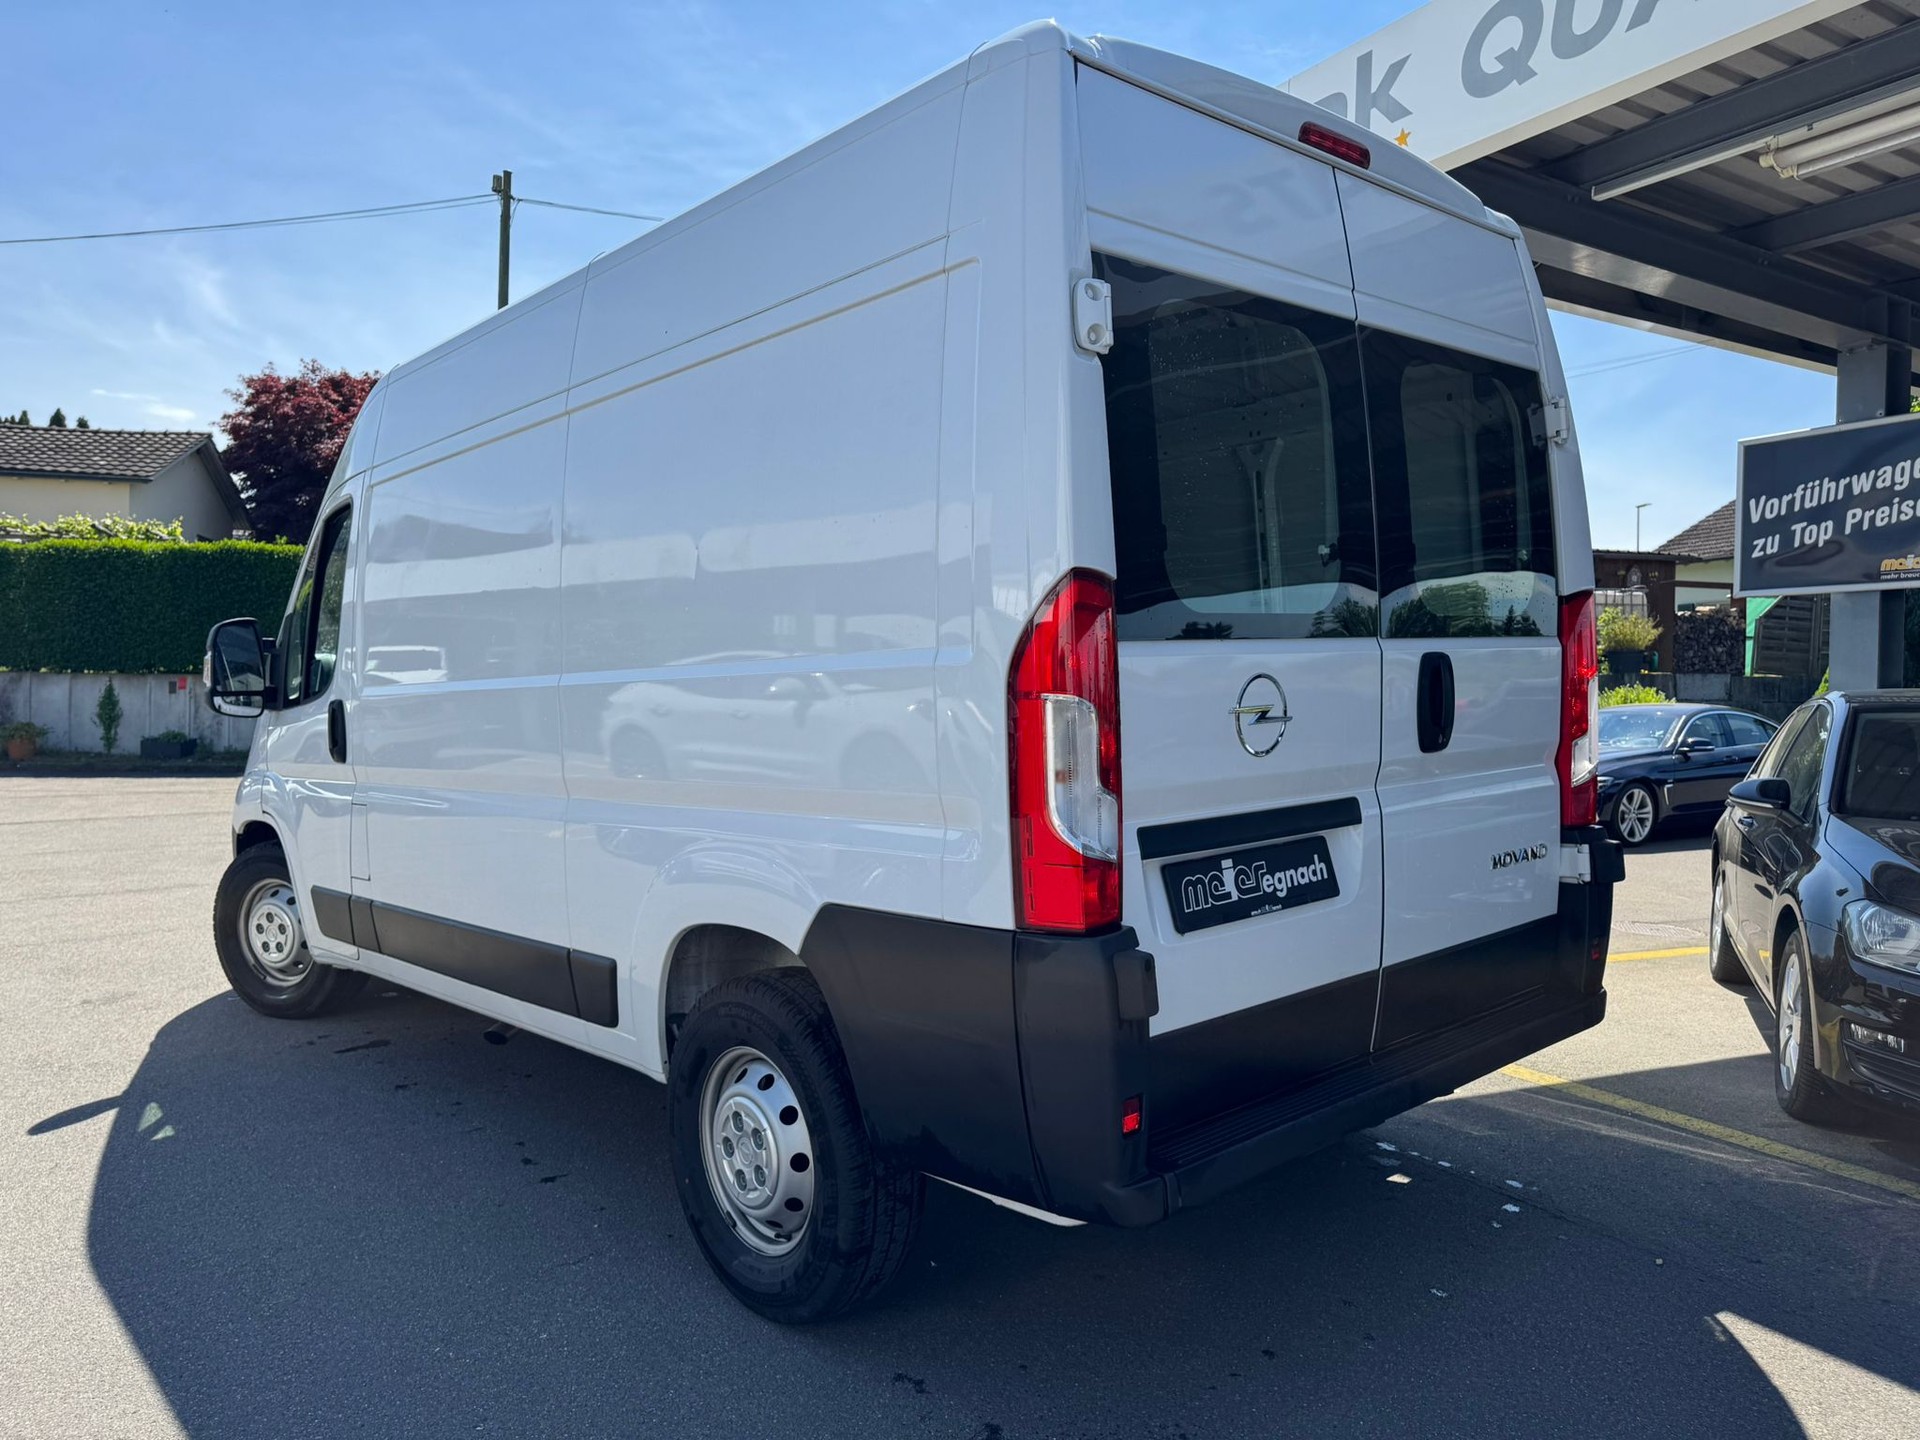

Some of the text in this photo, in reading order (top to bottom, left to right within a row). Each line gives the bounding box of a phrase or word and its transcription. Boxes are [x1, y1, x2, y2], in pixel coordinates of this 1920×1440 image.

[1313, 50, 1414, 130] k
[1751, 534, 1780, 558] zu
[1791, 519, 1834, 548] Top
[1491, 843, 1549, 871] MOVANO
